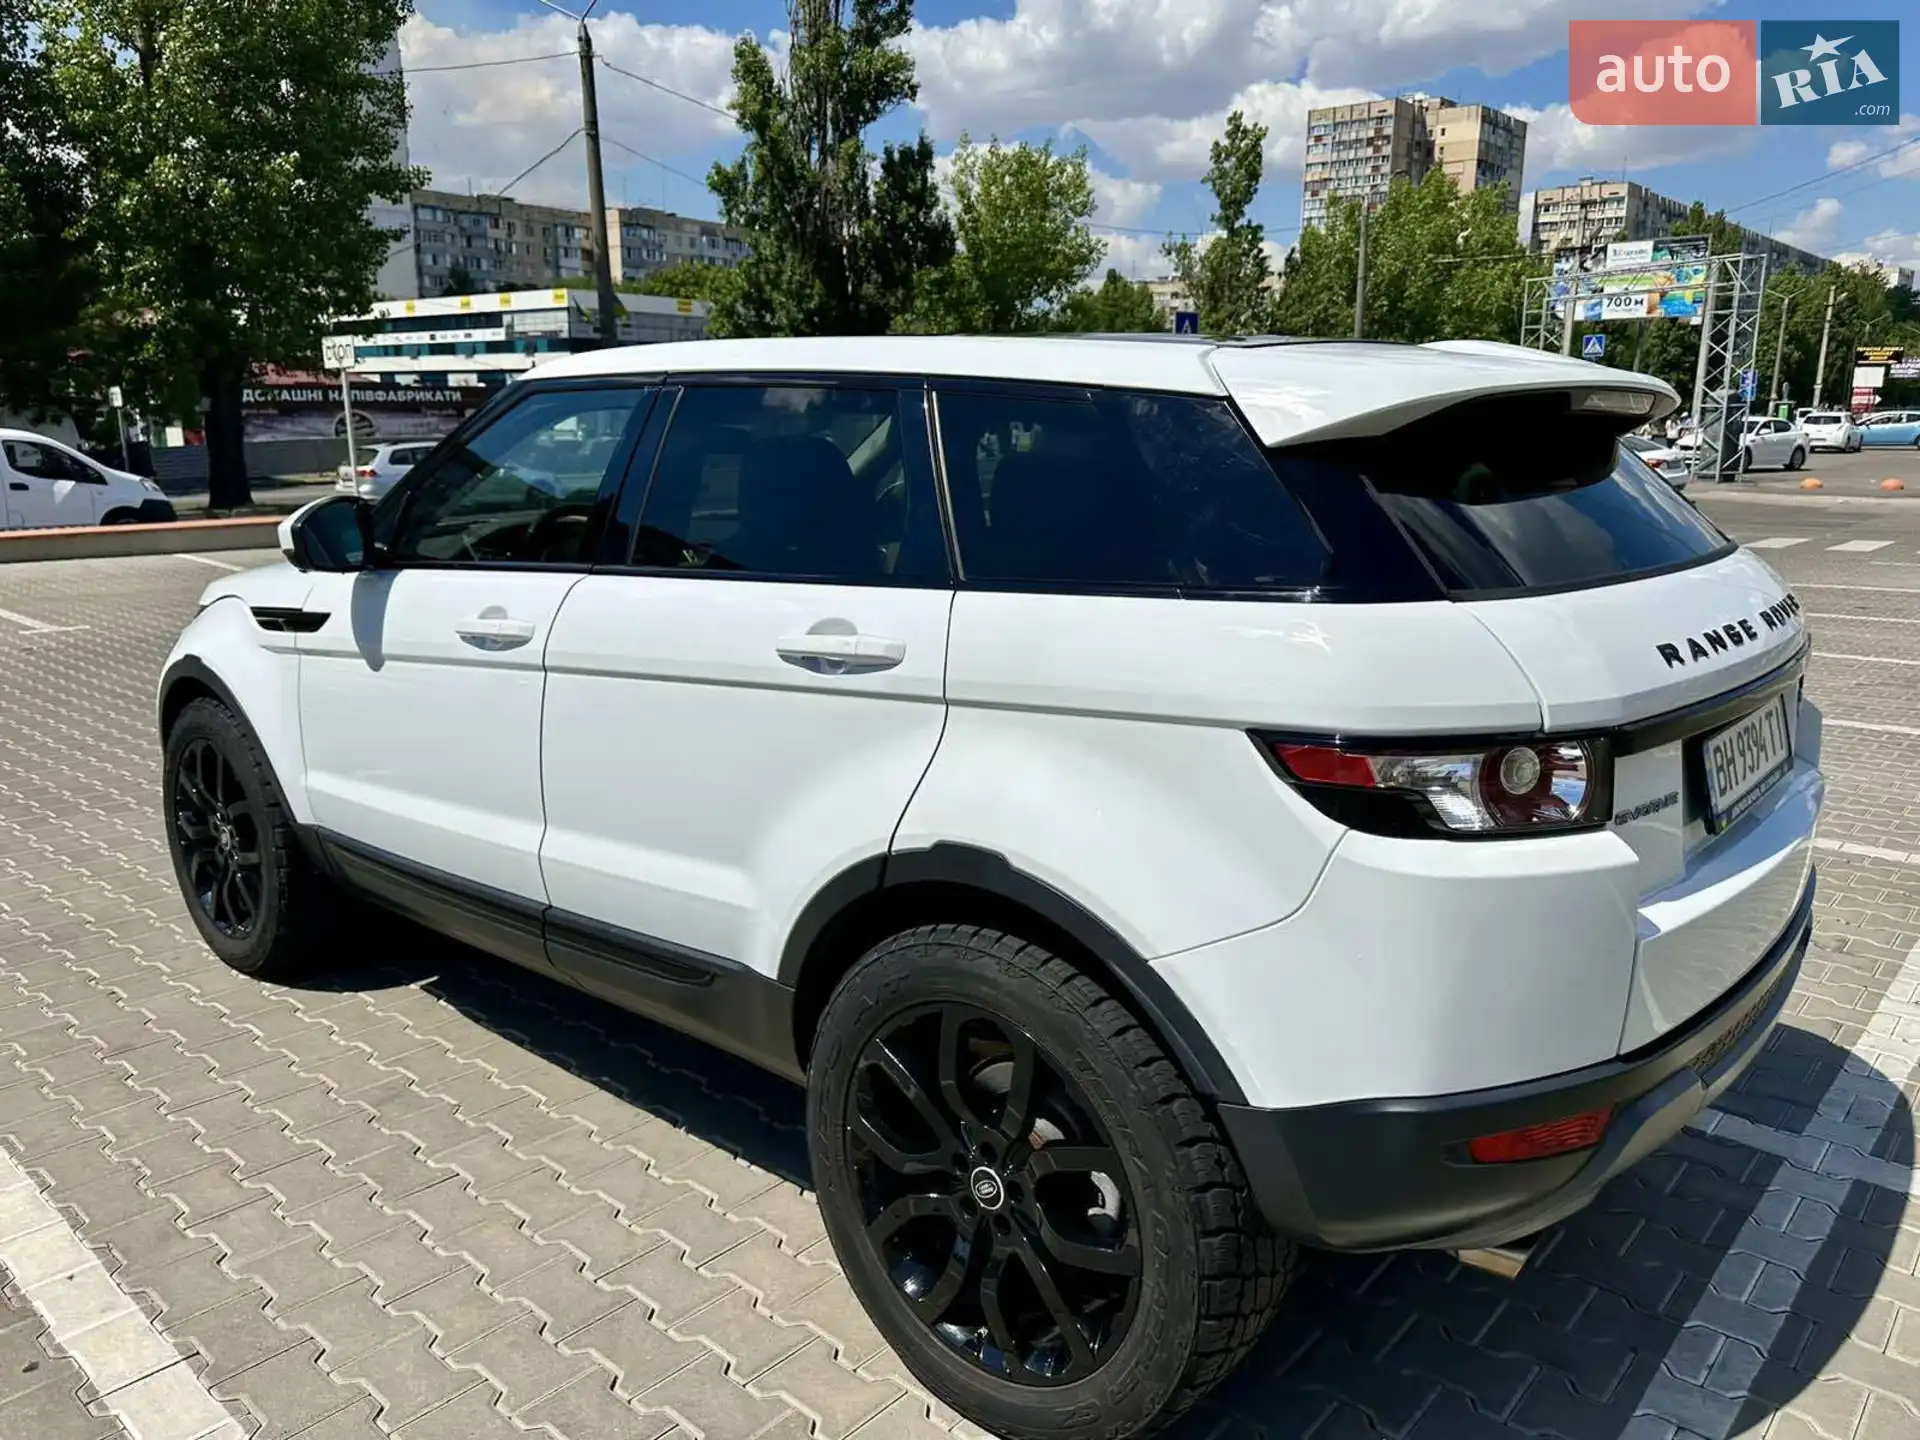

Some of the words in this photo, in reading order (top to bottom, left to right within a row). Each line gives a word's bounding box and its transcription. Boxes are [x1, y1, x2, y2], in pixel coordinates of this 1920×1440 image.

[1606, 296, 1632, 308] 700
[1656, 618, 1758, 669] RANGE
[1713, 736, 1739, 798] BH
[1737, 715, 1769, 782] 9394
